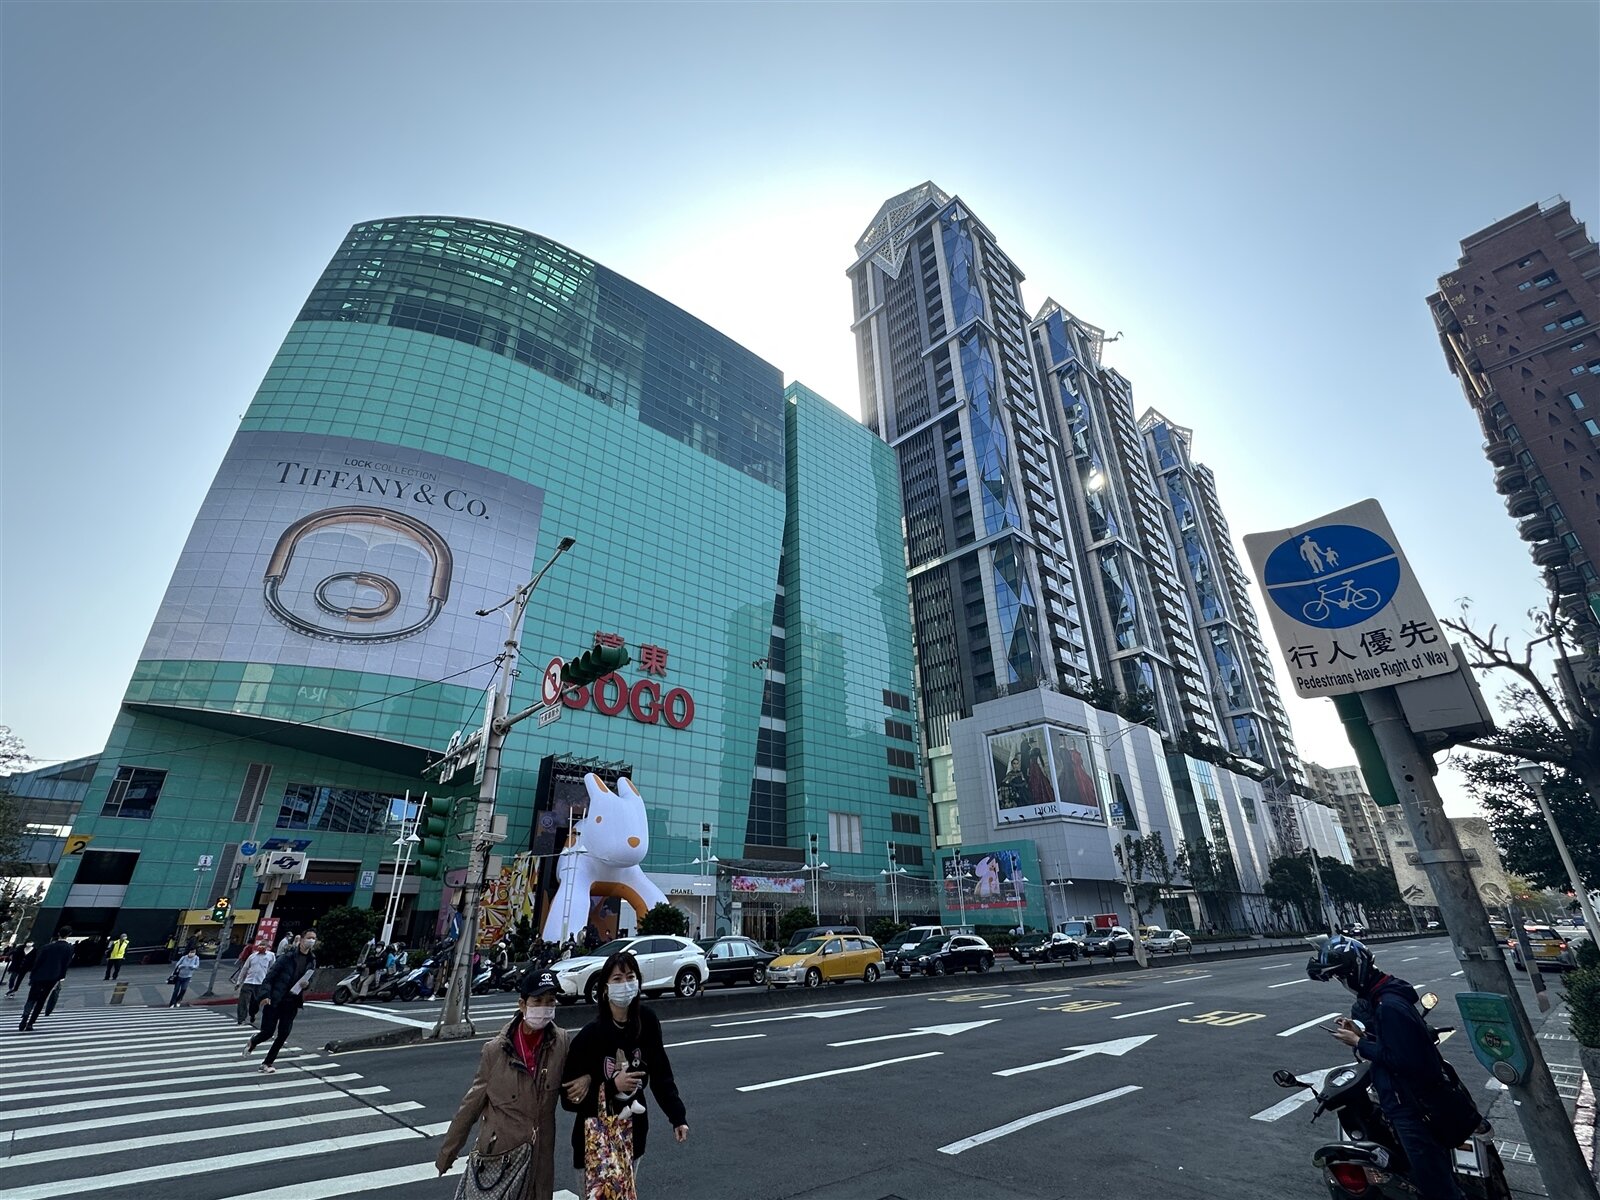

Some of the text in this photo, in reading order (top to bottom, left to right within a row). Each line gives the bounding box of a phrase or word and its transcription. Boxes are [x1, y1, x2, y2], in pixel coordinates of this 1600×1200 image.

[344, 457, 438, 482] LOCK COLLECTION
[276, 461, 490, 521] TIFFANY & CO.
[1287, 620, 1439, 669] 行人優先
[1297, 650, 1449, 690] Pedestrians Have Right of Way
[561, 671, 695, 729] SOGO
[1110, 803, 1118, 812] P
[70, 841, 86, 855] 2
[217, 898, 228, 908] 25
[1178, 1011, 1266, 1026] 50
